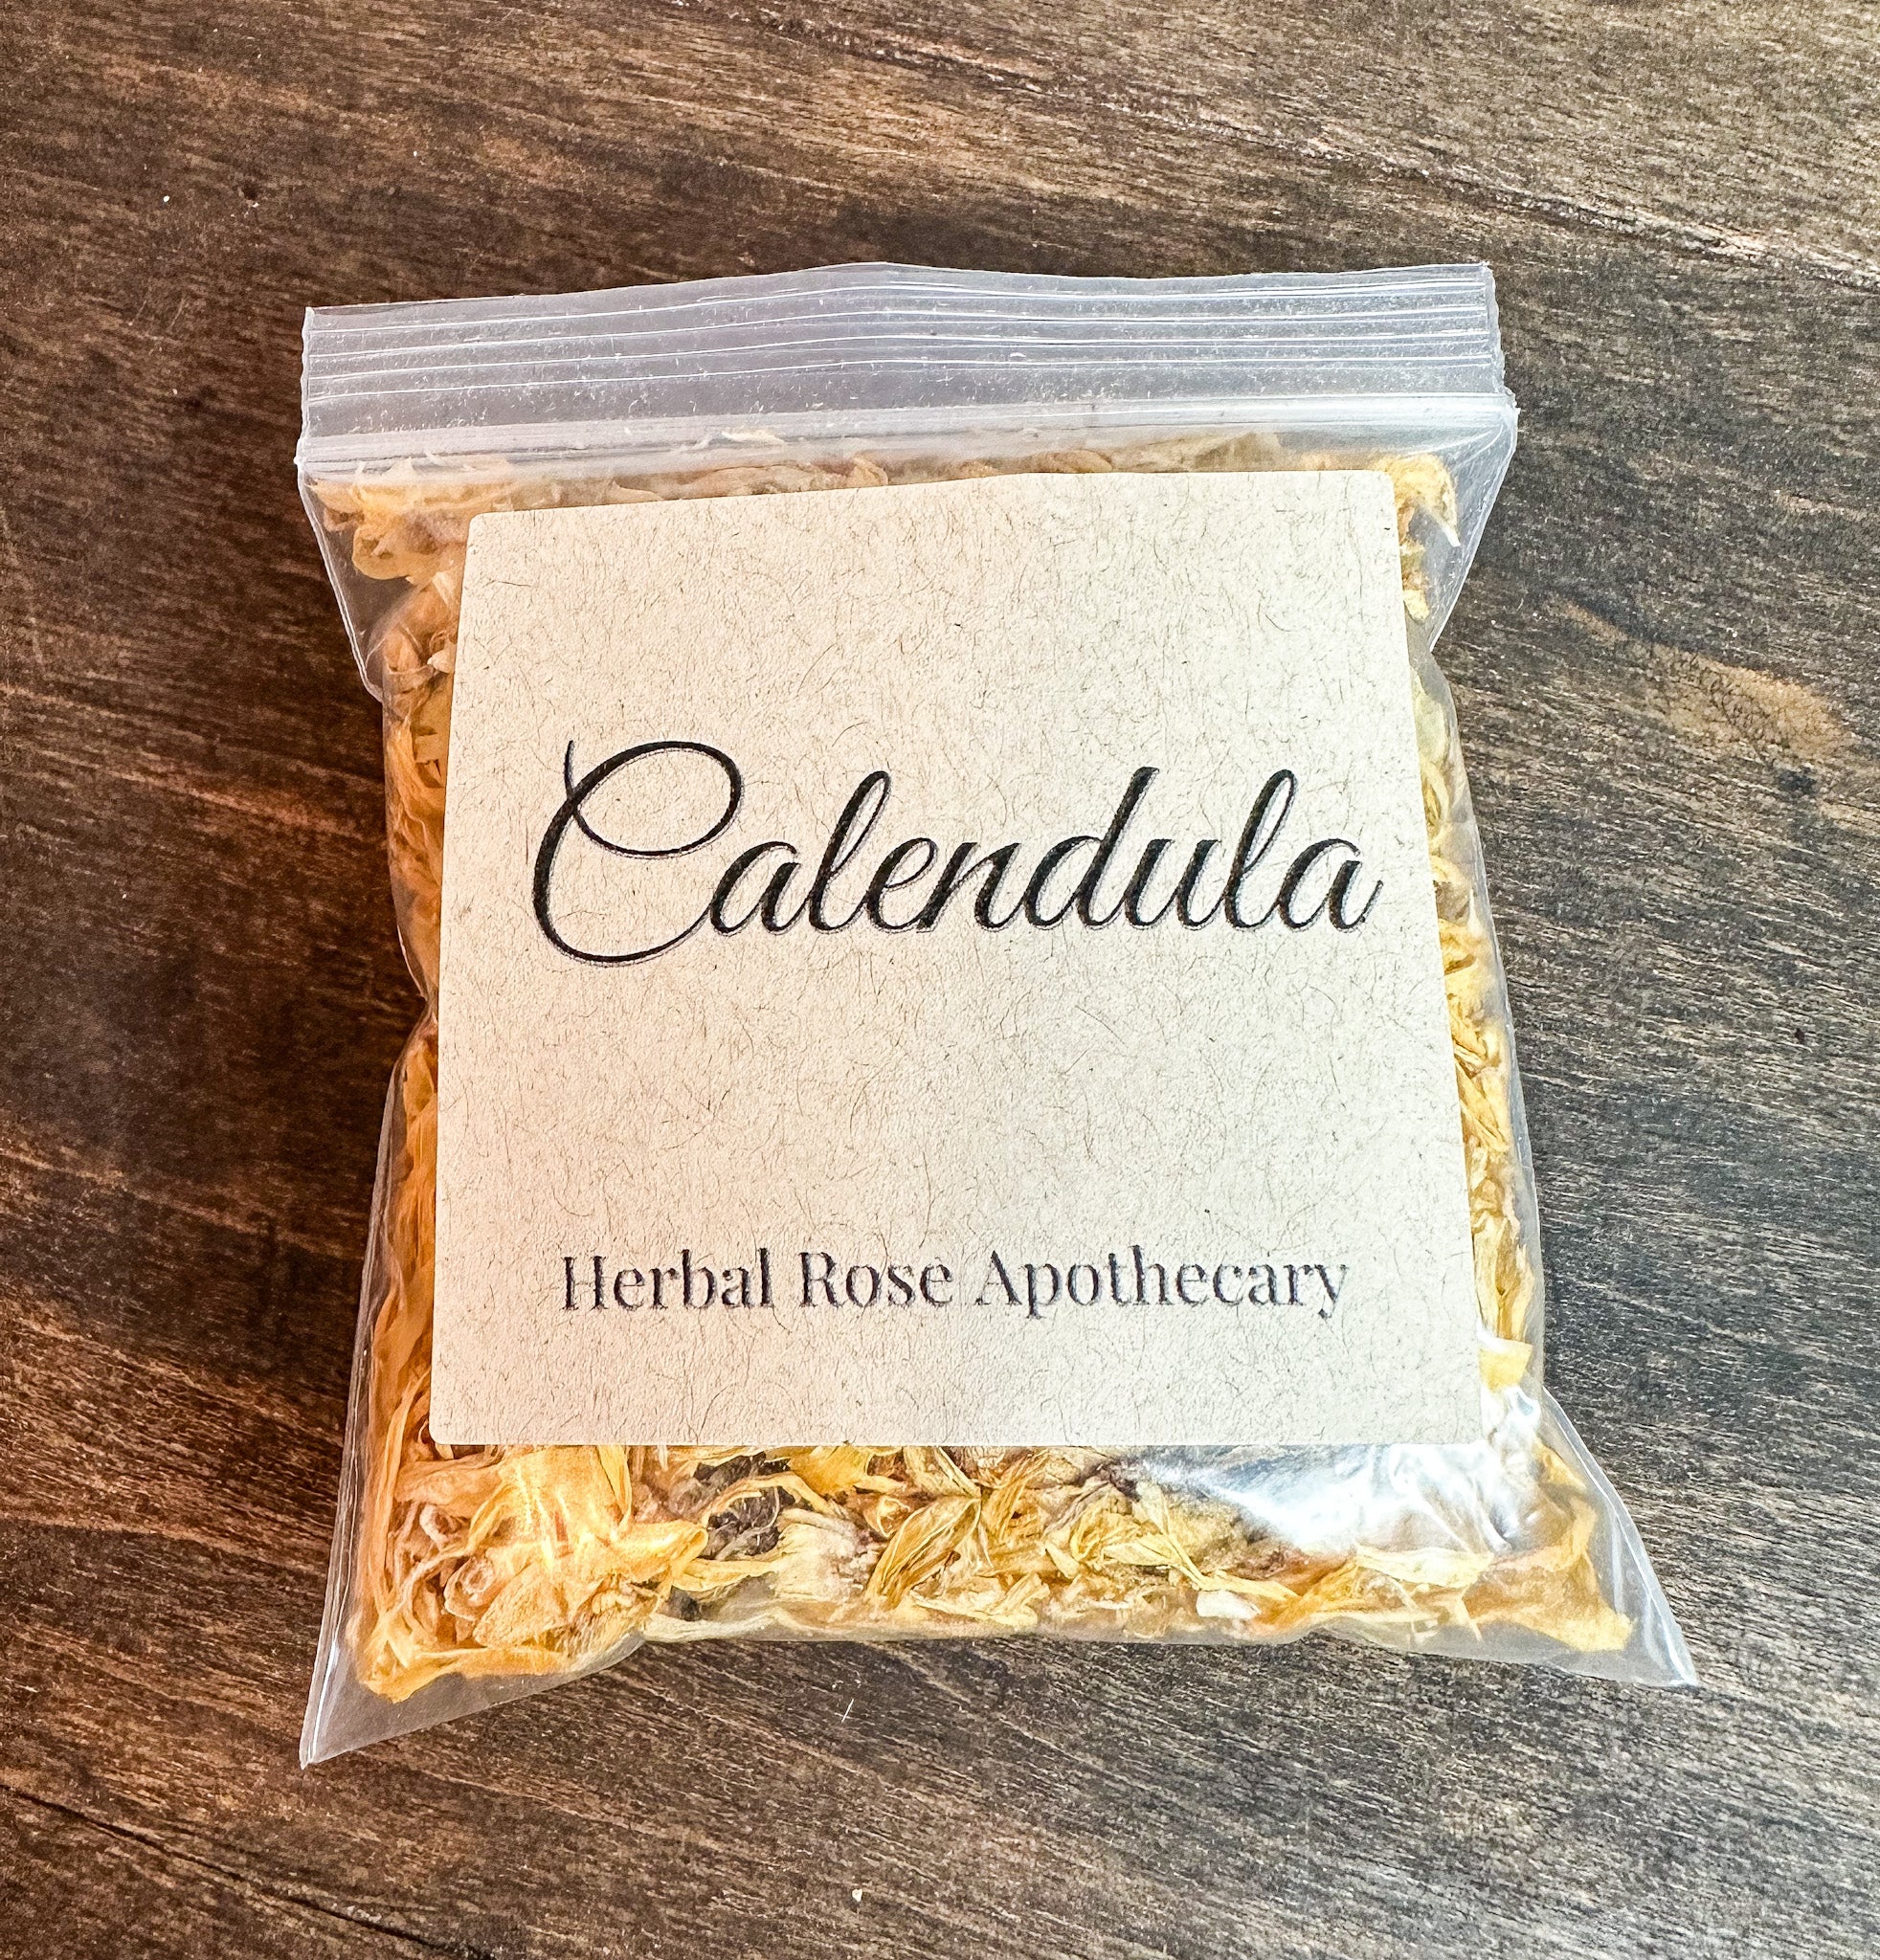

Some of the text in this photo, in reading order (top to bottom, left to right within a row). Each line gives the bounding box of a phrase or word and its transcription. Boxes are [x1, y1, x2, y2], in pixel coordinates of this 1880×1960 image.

[531, 739, 1384, 966] Calendula
[561, 1245, 1349, 1320] Herbal Rose Apothecary
